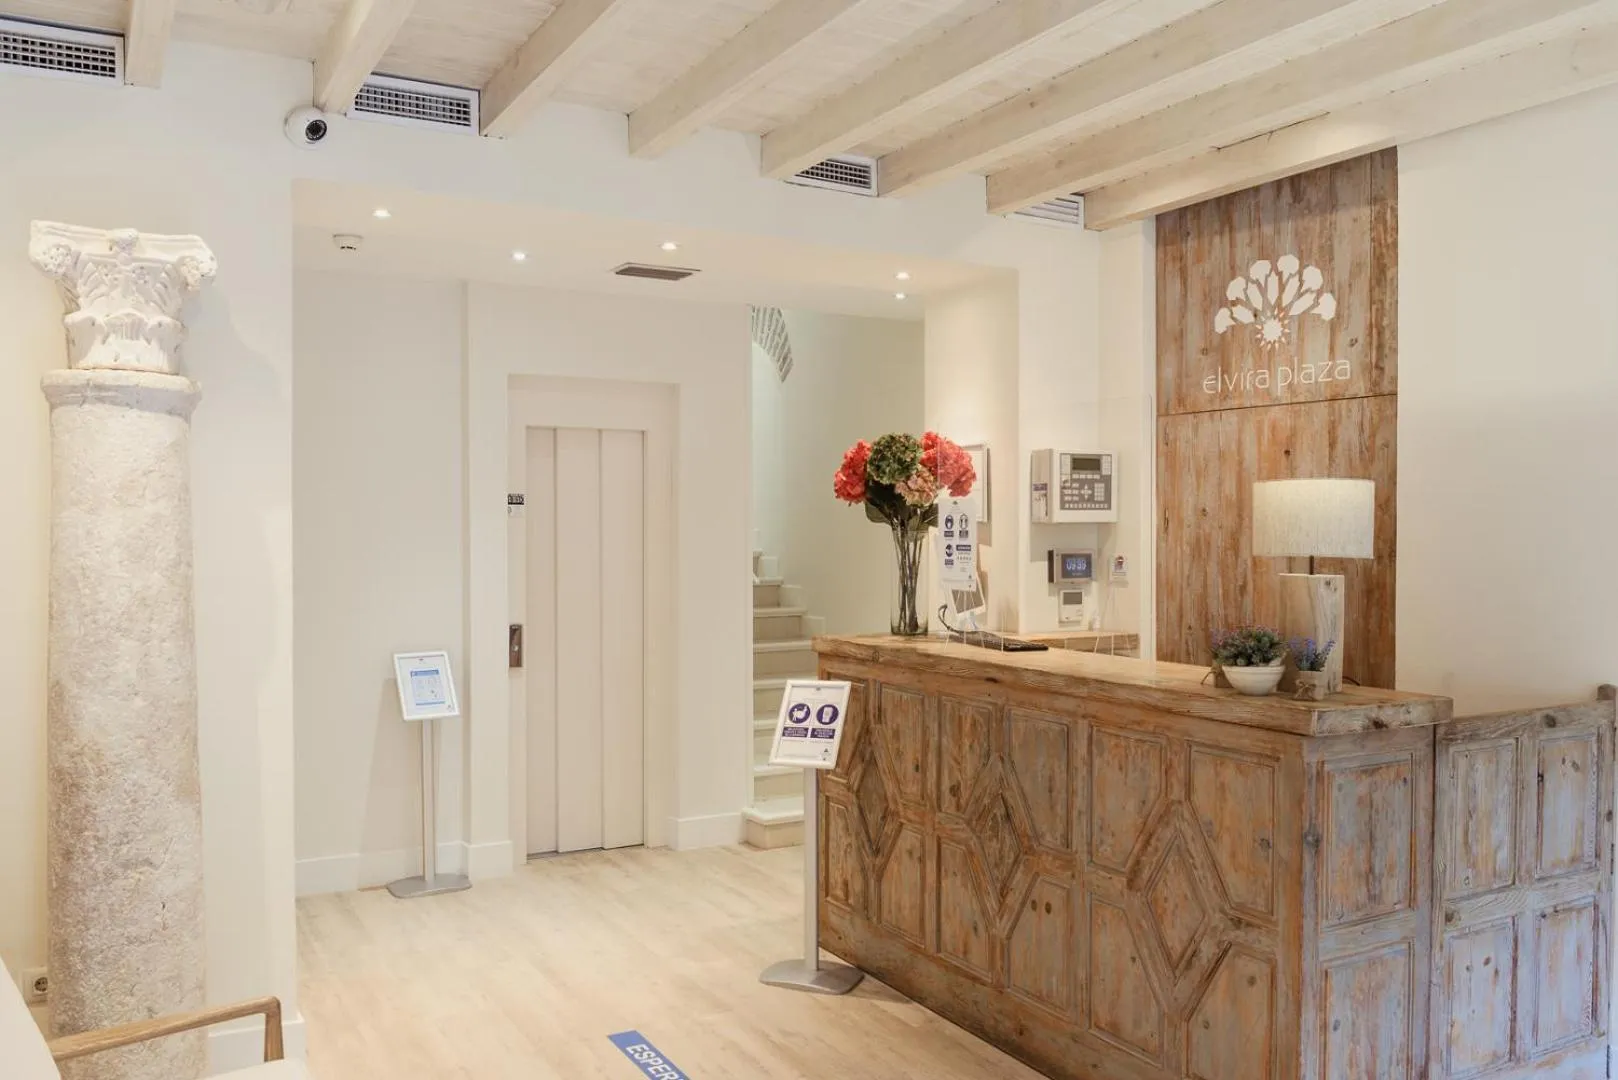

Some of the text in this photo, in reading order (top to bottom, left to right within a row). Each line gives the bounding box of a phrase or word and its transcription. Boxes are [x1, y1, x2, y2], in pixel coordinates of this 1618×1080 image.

[1202, 356, 1351, 396] elvira plaza
[625, 1043, 684, 1080] ESPER
